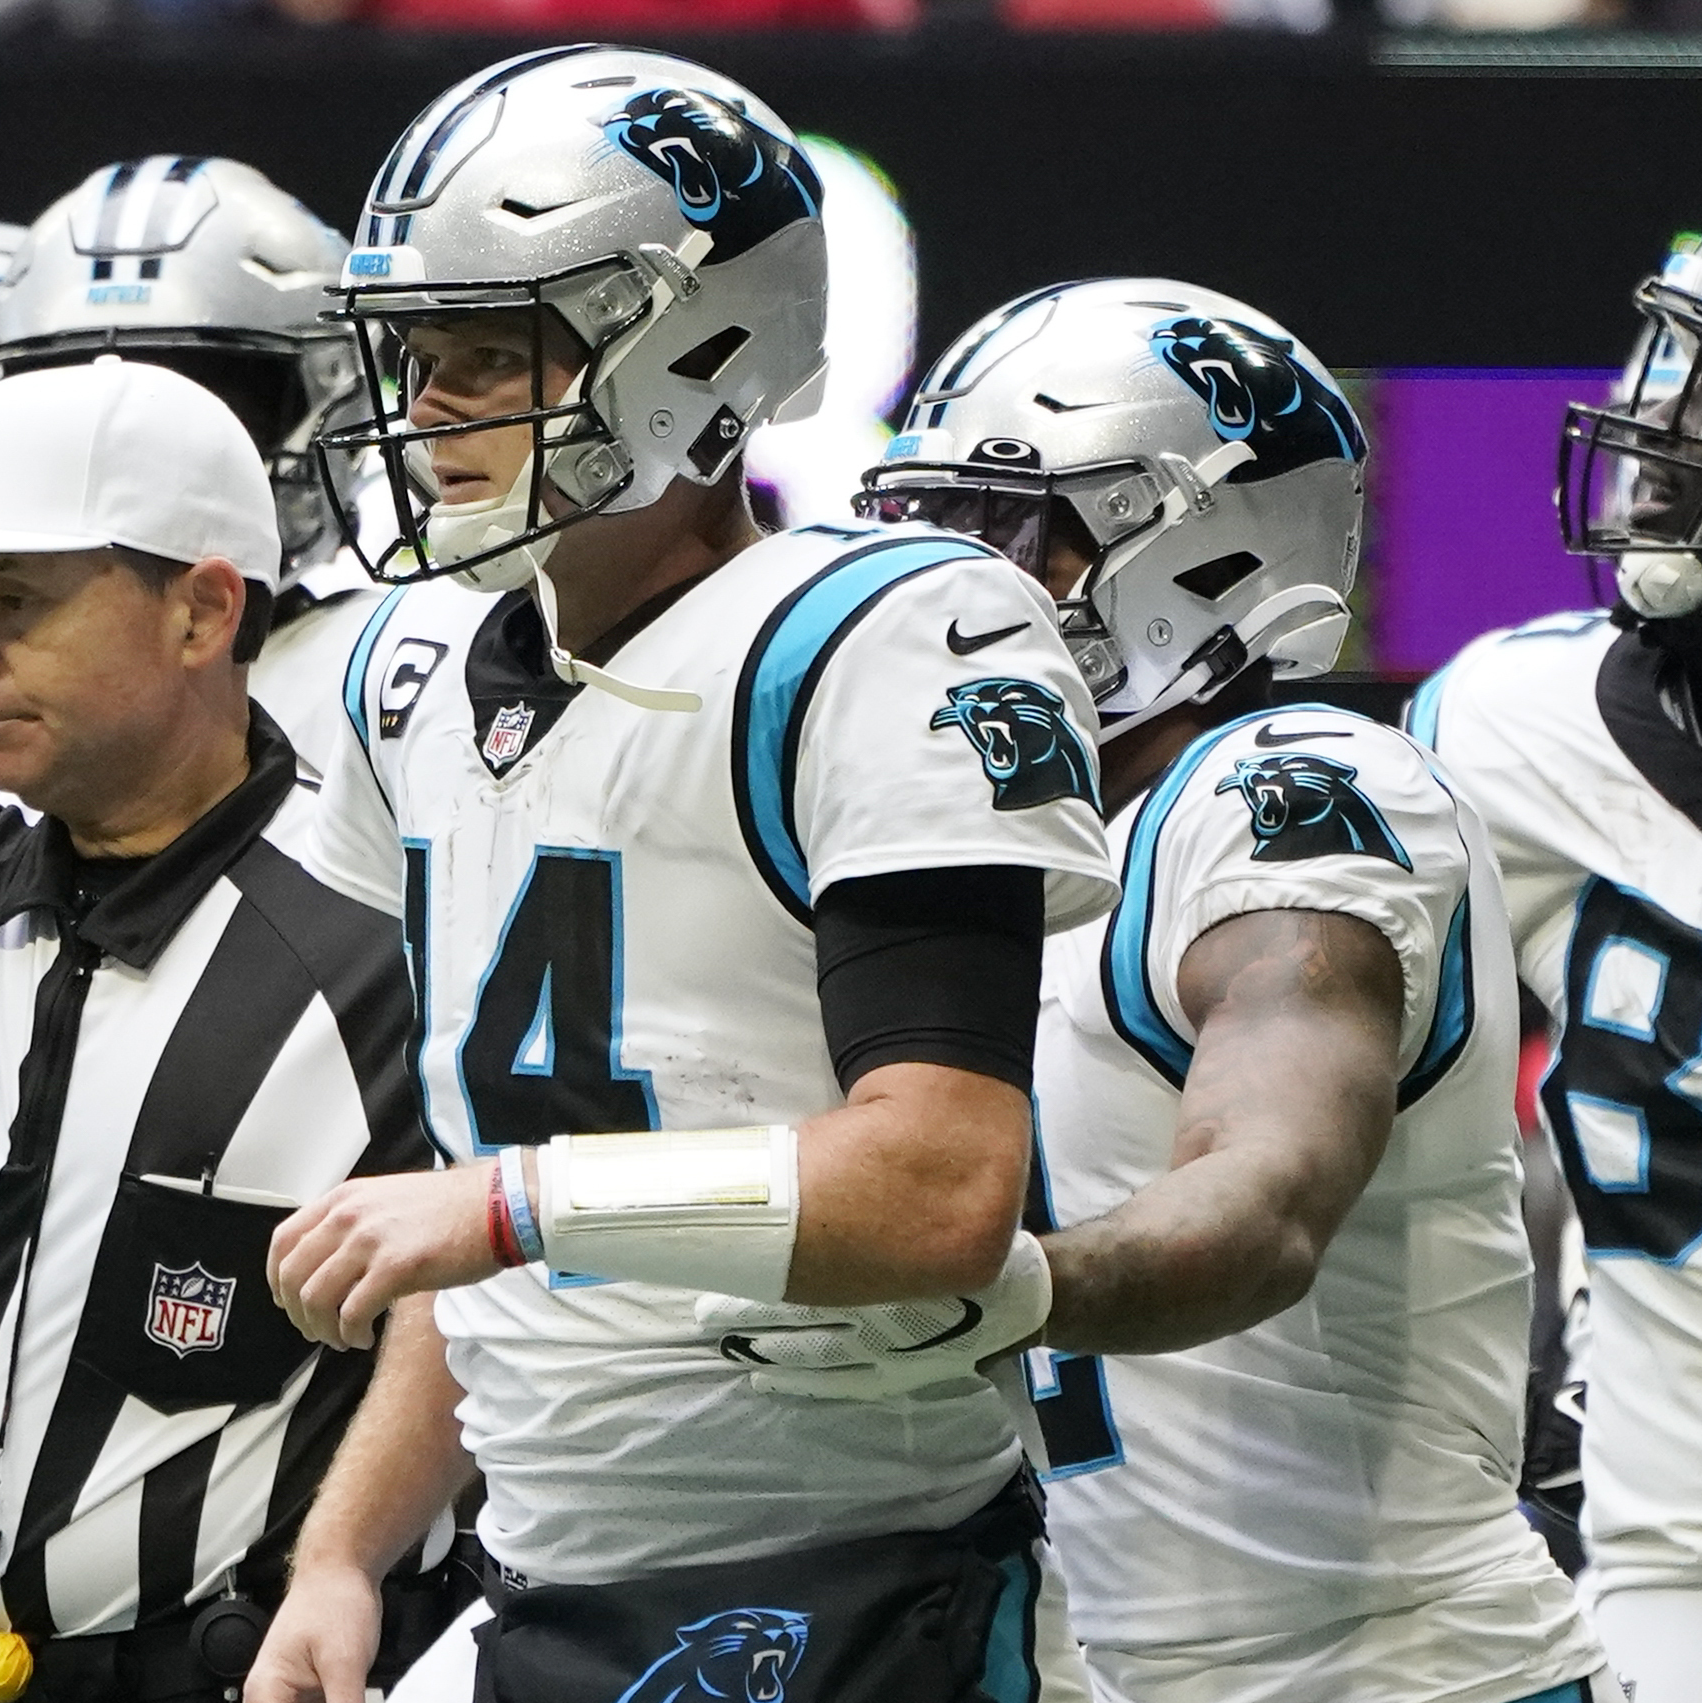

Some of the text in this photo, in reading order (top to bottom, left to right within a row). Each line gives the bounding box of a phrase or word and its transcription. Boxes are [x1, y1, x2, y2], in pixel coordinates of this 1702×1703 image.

[381, 642, 438, 711] C
[490, 728, 518, 755] NFL
[152, 1295, 219, 1346] NFL
